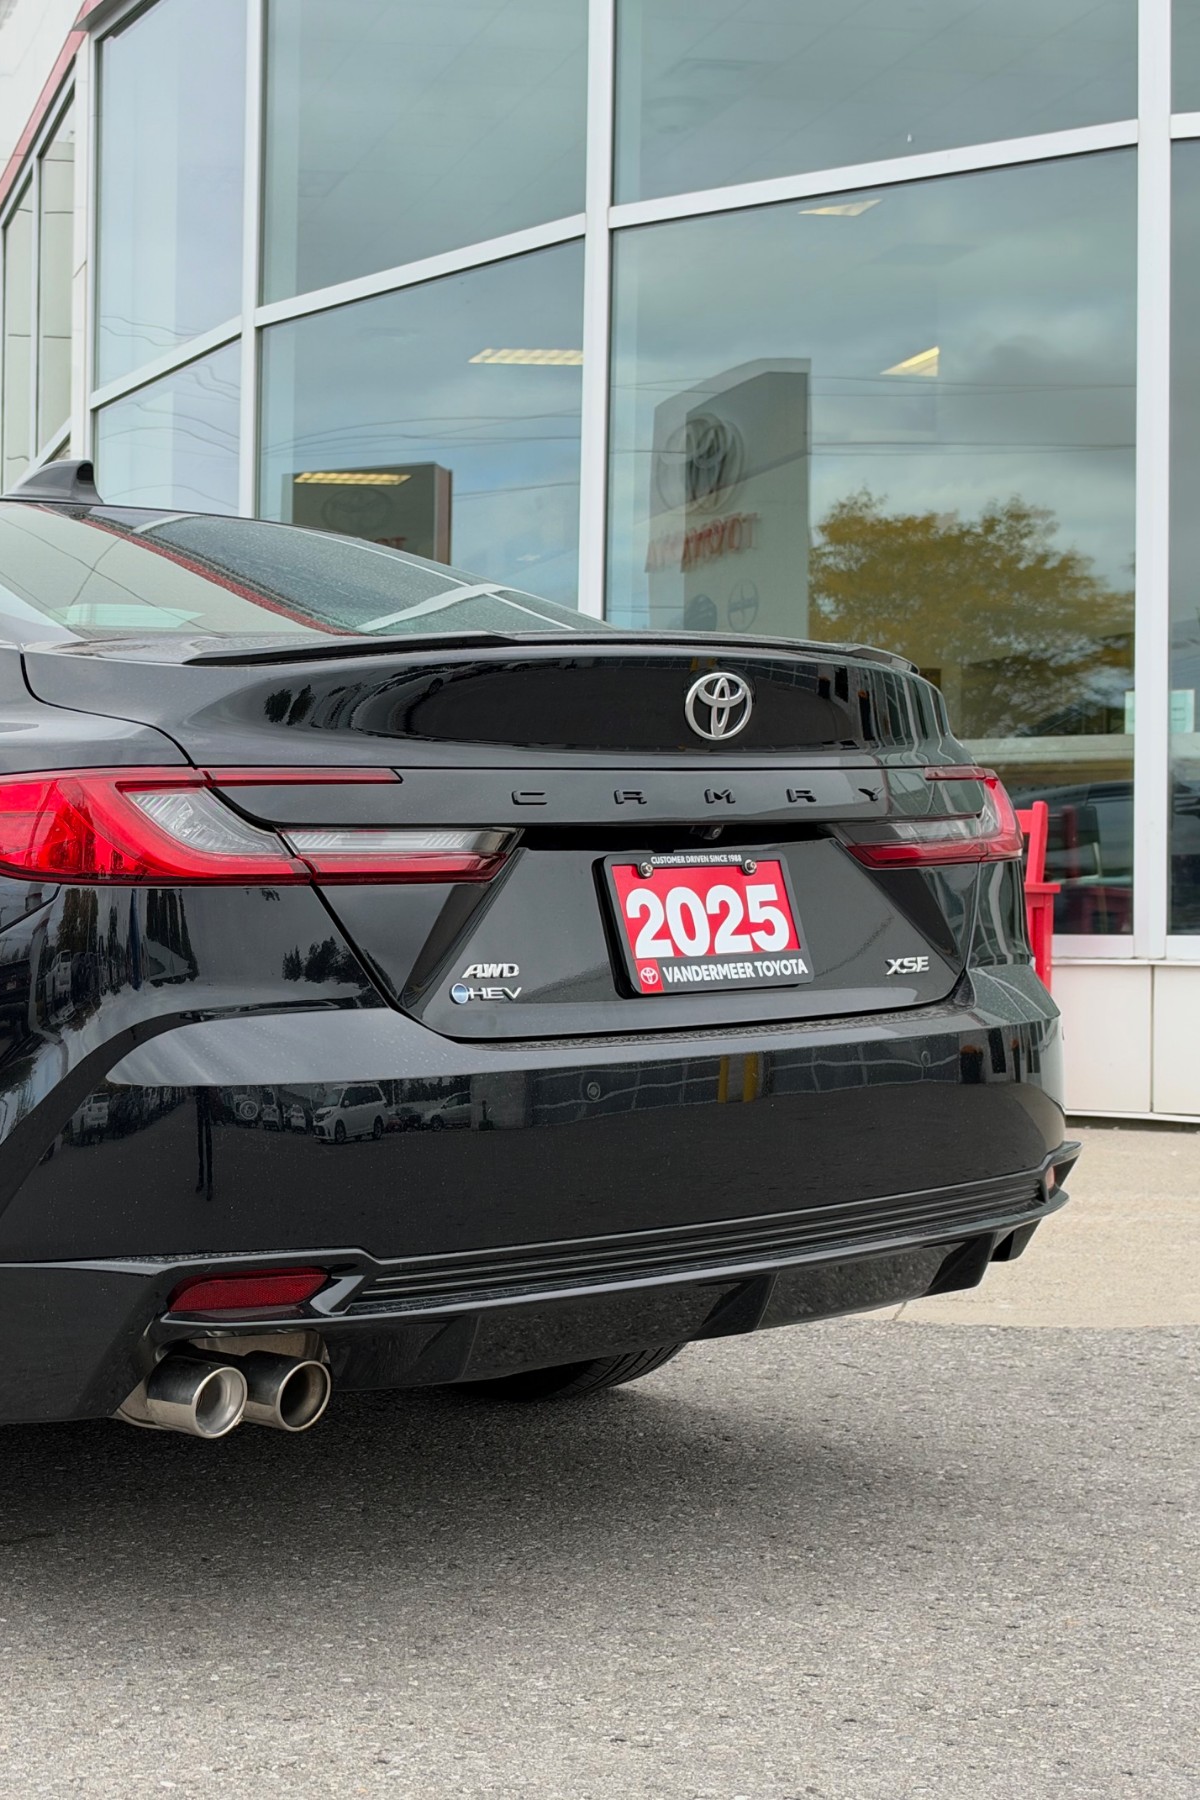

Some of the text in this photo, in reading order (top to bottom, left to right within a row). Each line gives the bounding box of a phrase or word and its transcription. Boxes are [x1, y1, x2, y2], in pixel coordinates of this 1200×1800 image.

[651, 854, 742, 865] CUSTOMER DRIVEN SINCE 1988
[626, 884, 790, 959] 2025
[461, 963, 520, 978] AWD
[662, 958, 808, 983] VANDERMEER TOYOTA
[886, 956, 930, 975] XSE
[468, 987, 522, 999] HEV
